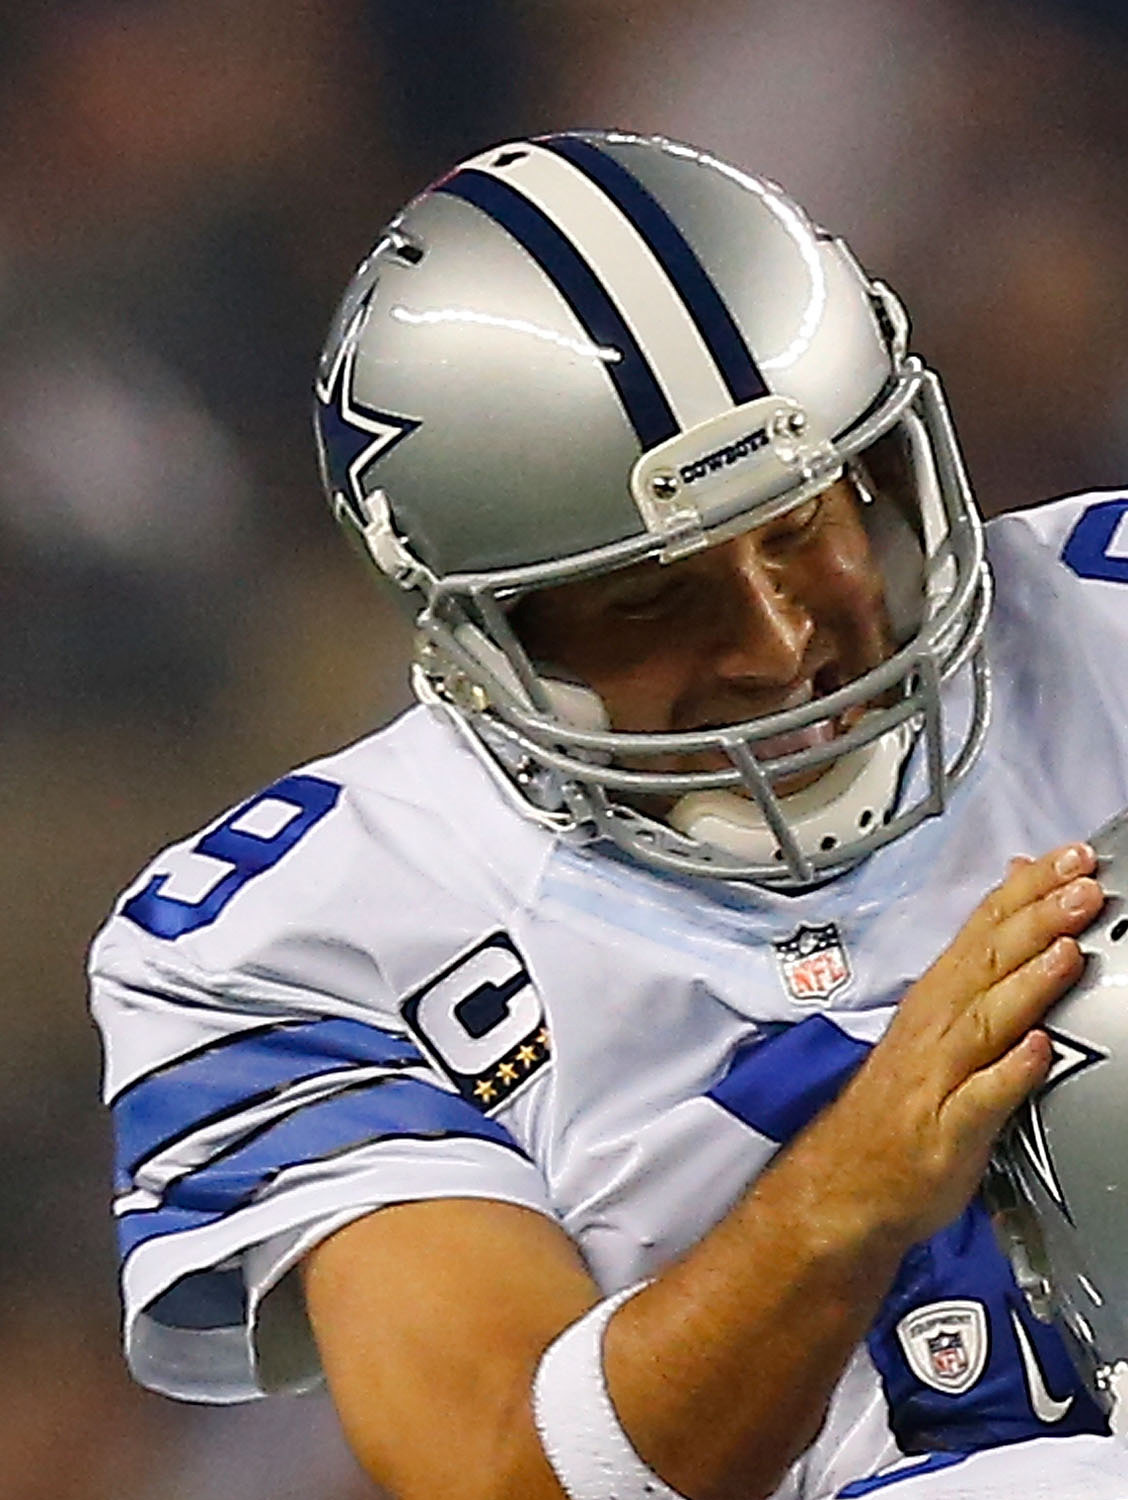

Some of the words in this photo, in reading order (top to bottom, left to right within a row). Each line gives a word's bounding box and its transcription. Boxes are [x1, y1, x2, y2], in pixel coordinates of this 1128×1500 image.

[121, 775, 343, 941] 9
[417, 946, 543, 1076] C
[792, 952, 845, 993] NFL
